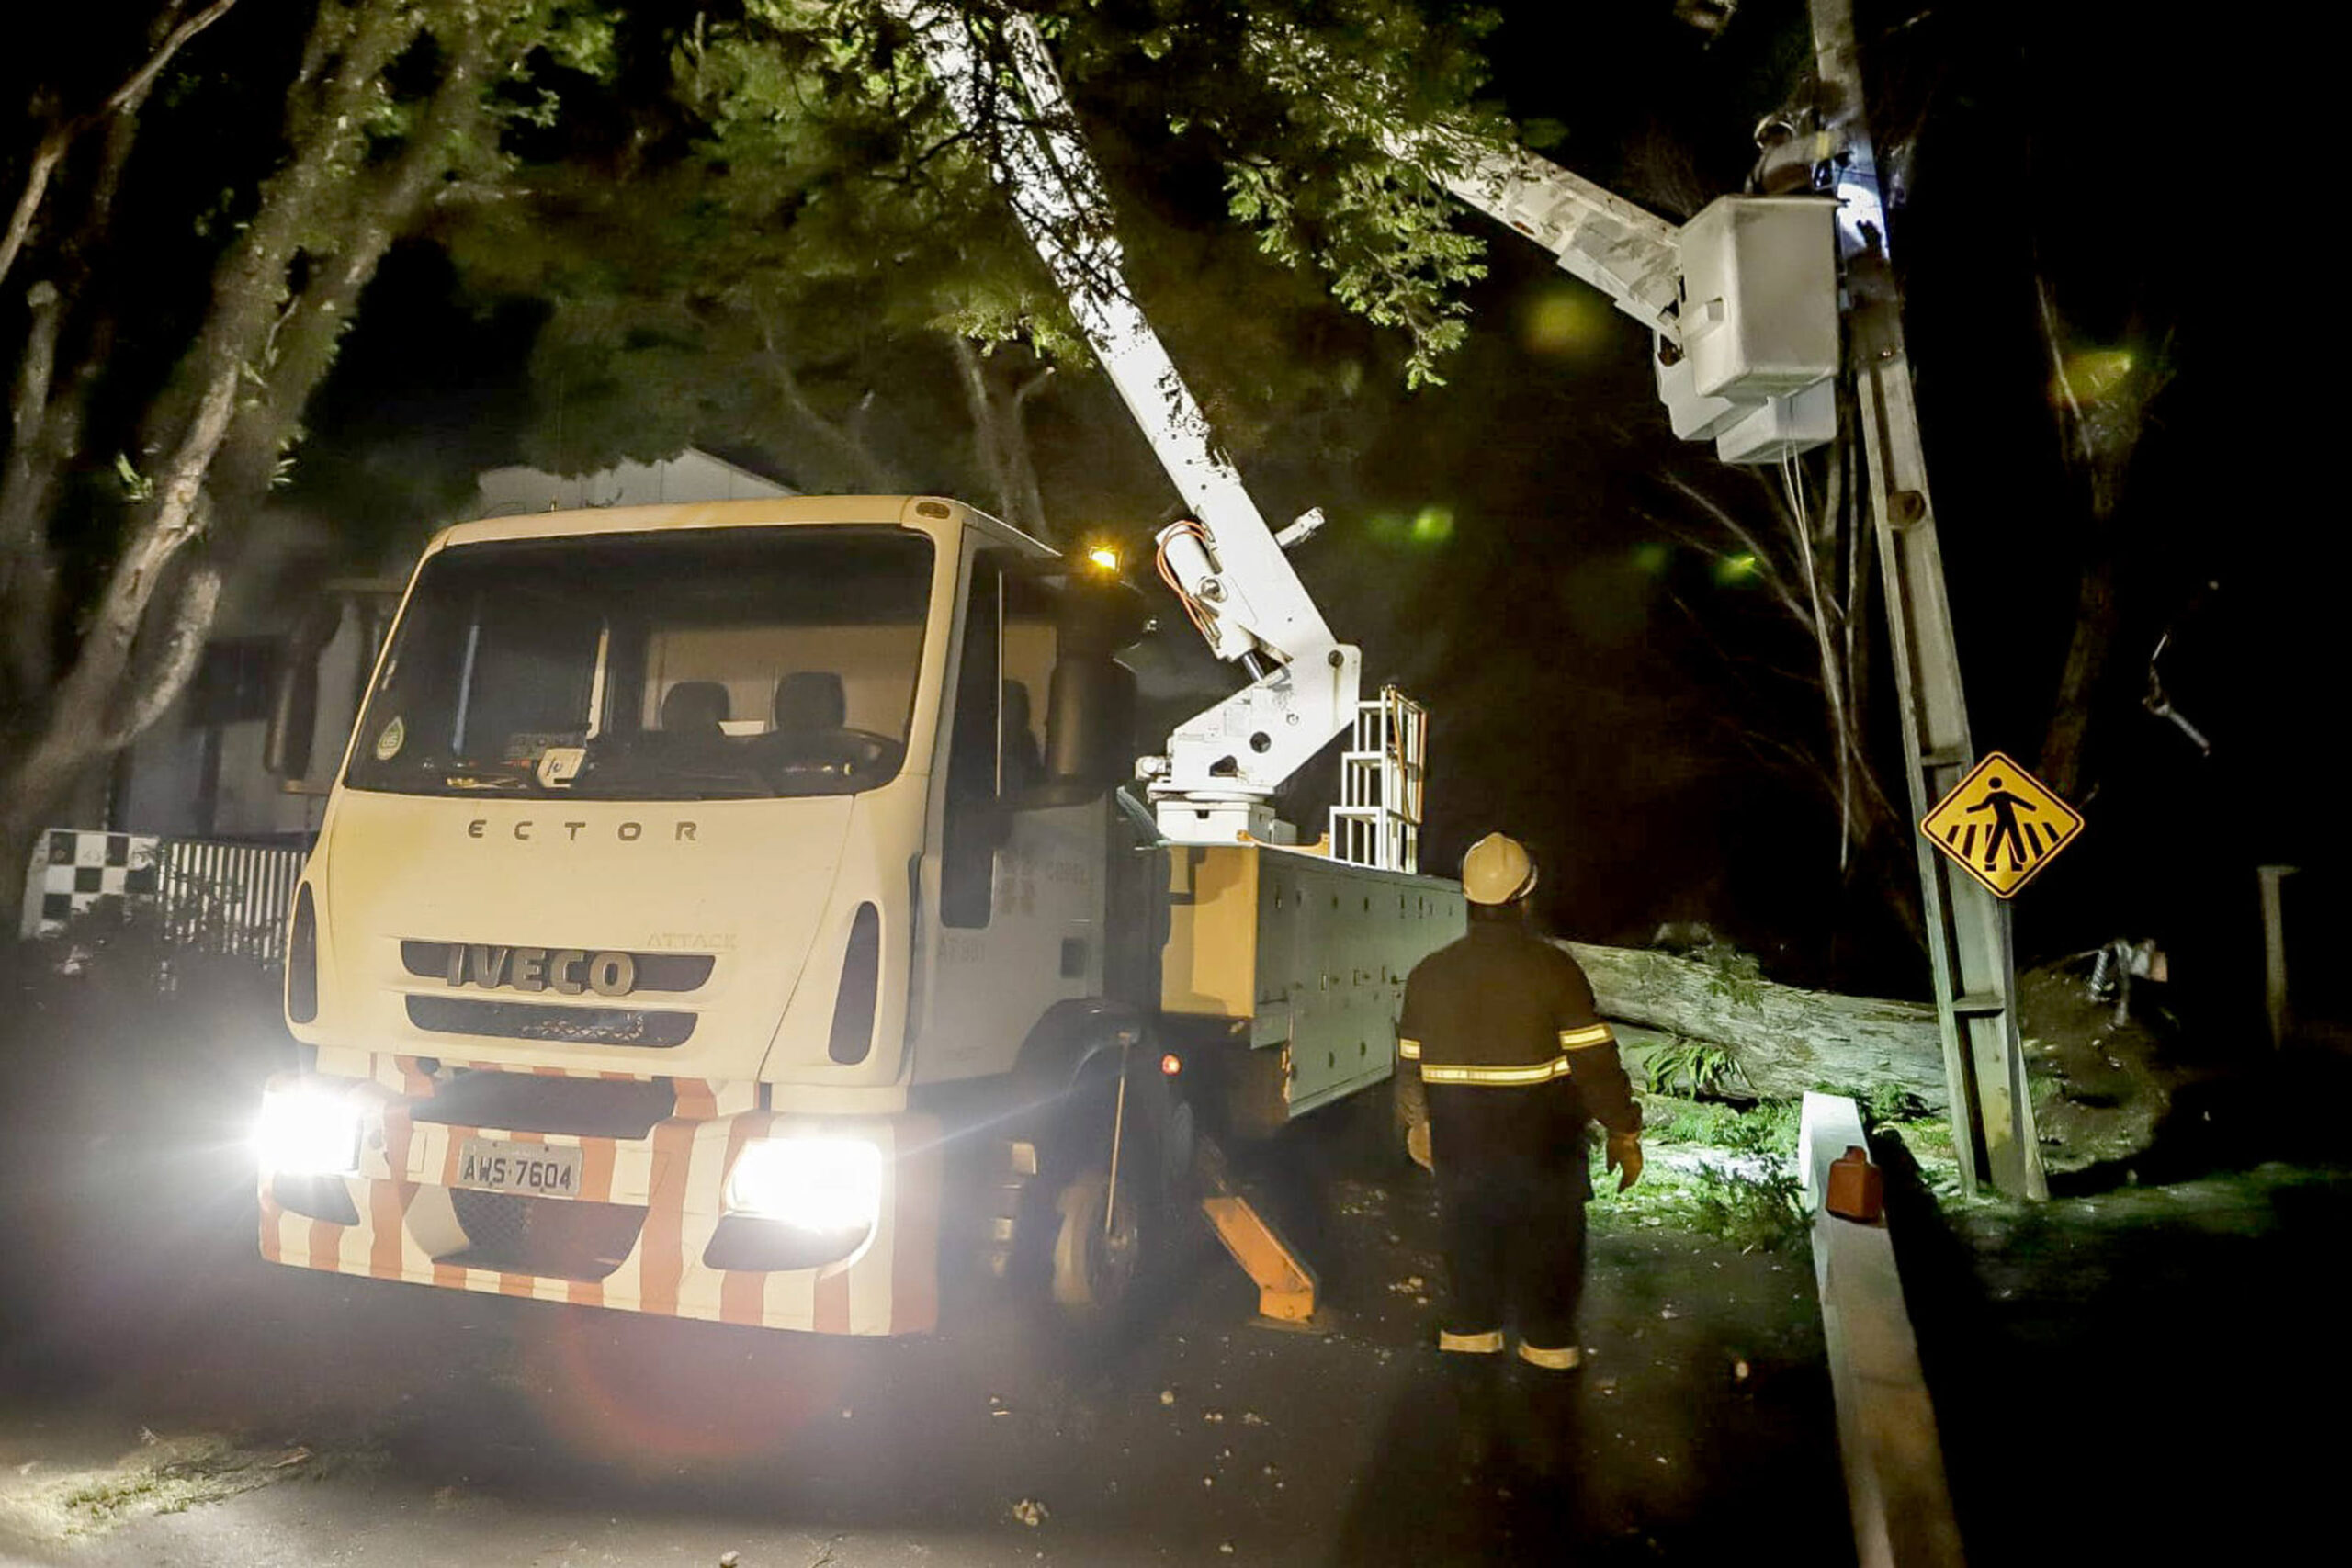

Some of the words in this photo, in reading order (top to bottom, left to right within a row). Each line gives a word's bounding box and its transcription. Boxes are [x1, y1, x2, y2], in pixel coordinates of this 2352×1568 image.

[468, 819, 697, 841] ECTOR
[646, 931, 738, 950] ATTACK
[447, 943, 636, 997] IVECO
